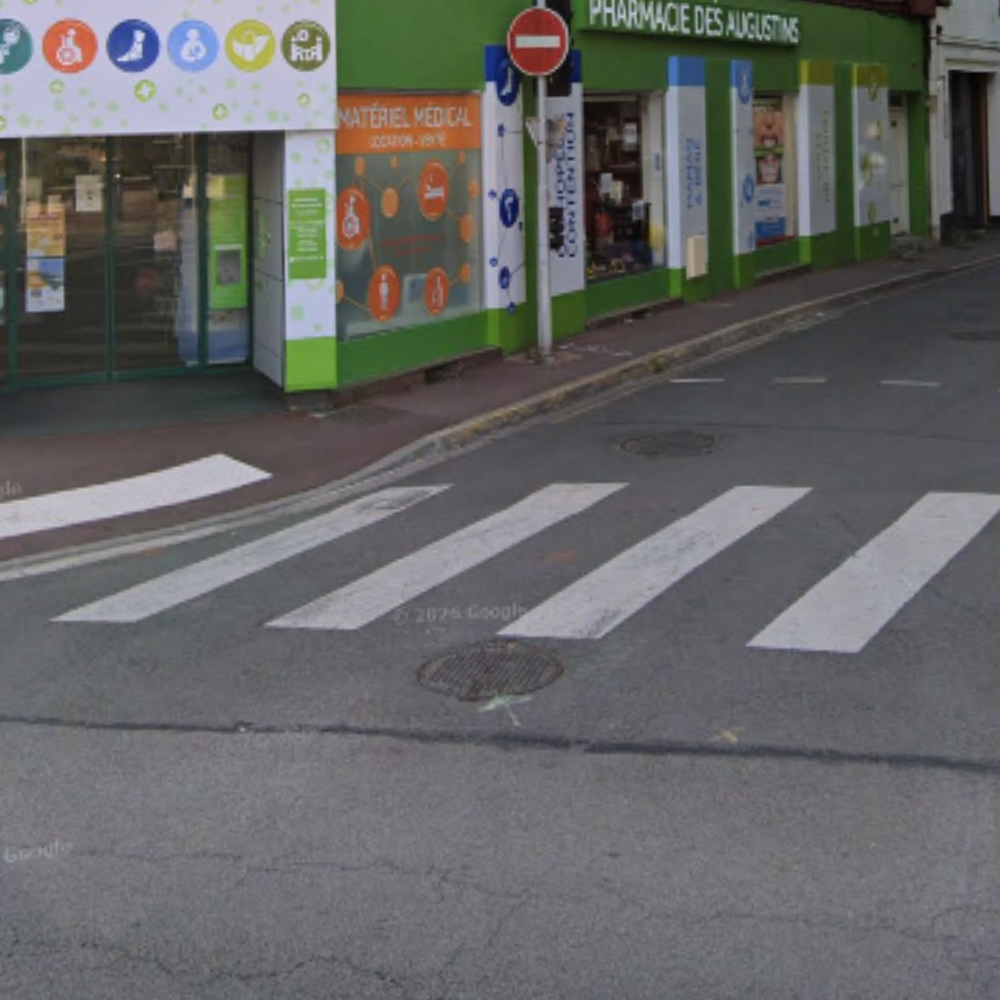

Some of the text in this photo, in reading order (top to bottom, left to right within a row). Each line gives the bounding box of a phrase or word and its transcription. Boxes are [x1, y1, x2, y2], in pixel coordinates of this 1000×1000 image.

[694, 3, 723, 37] DES
[725, 9, 800, 44] AUGUSTINS
[338, 101, 472, 130] MATÉRIEL MÉDICAL
[566, 111, 577, 259] CONTENTION
